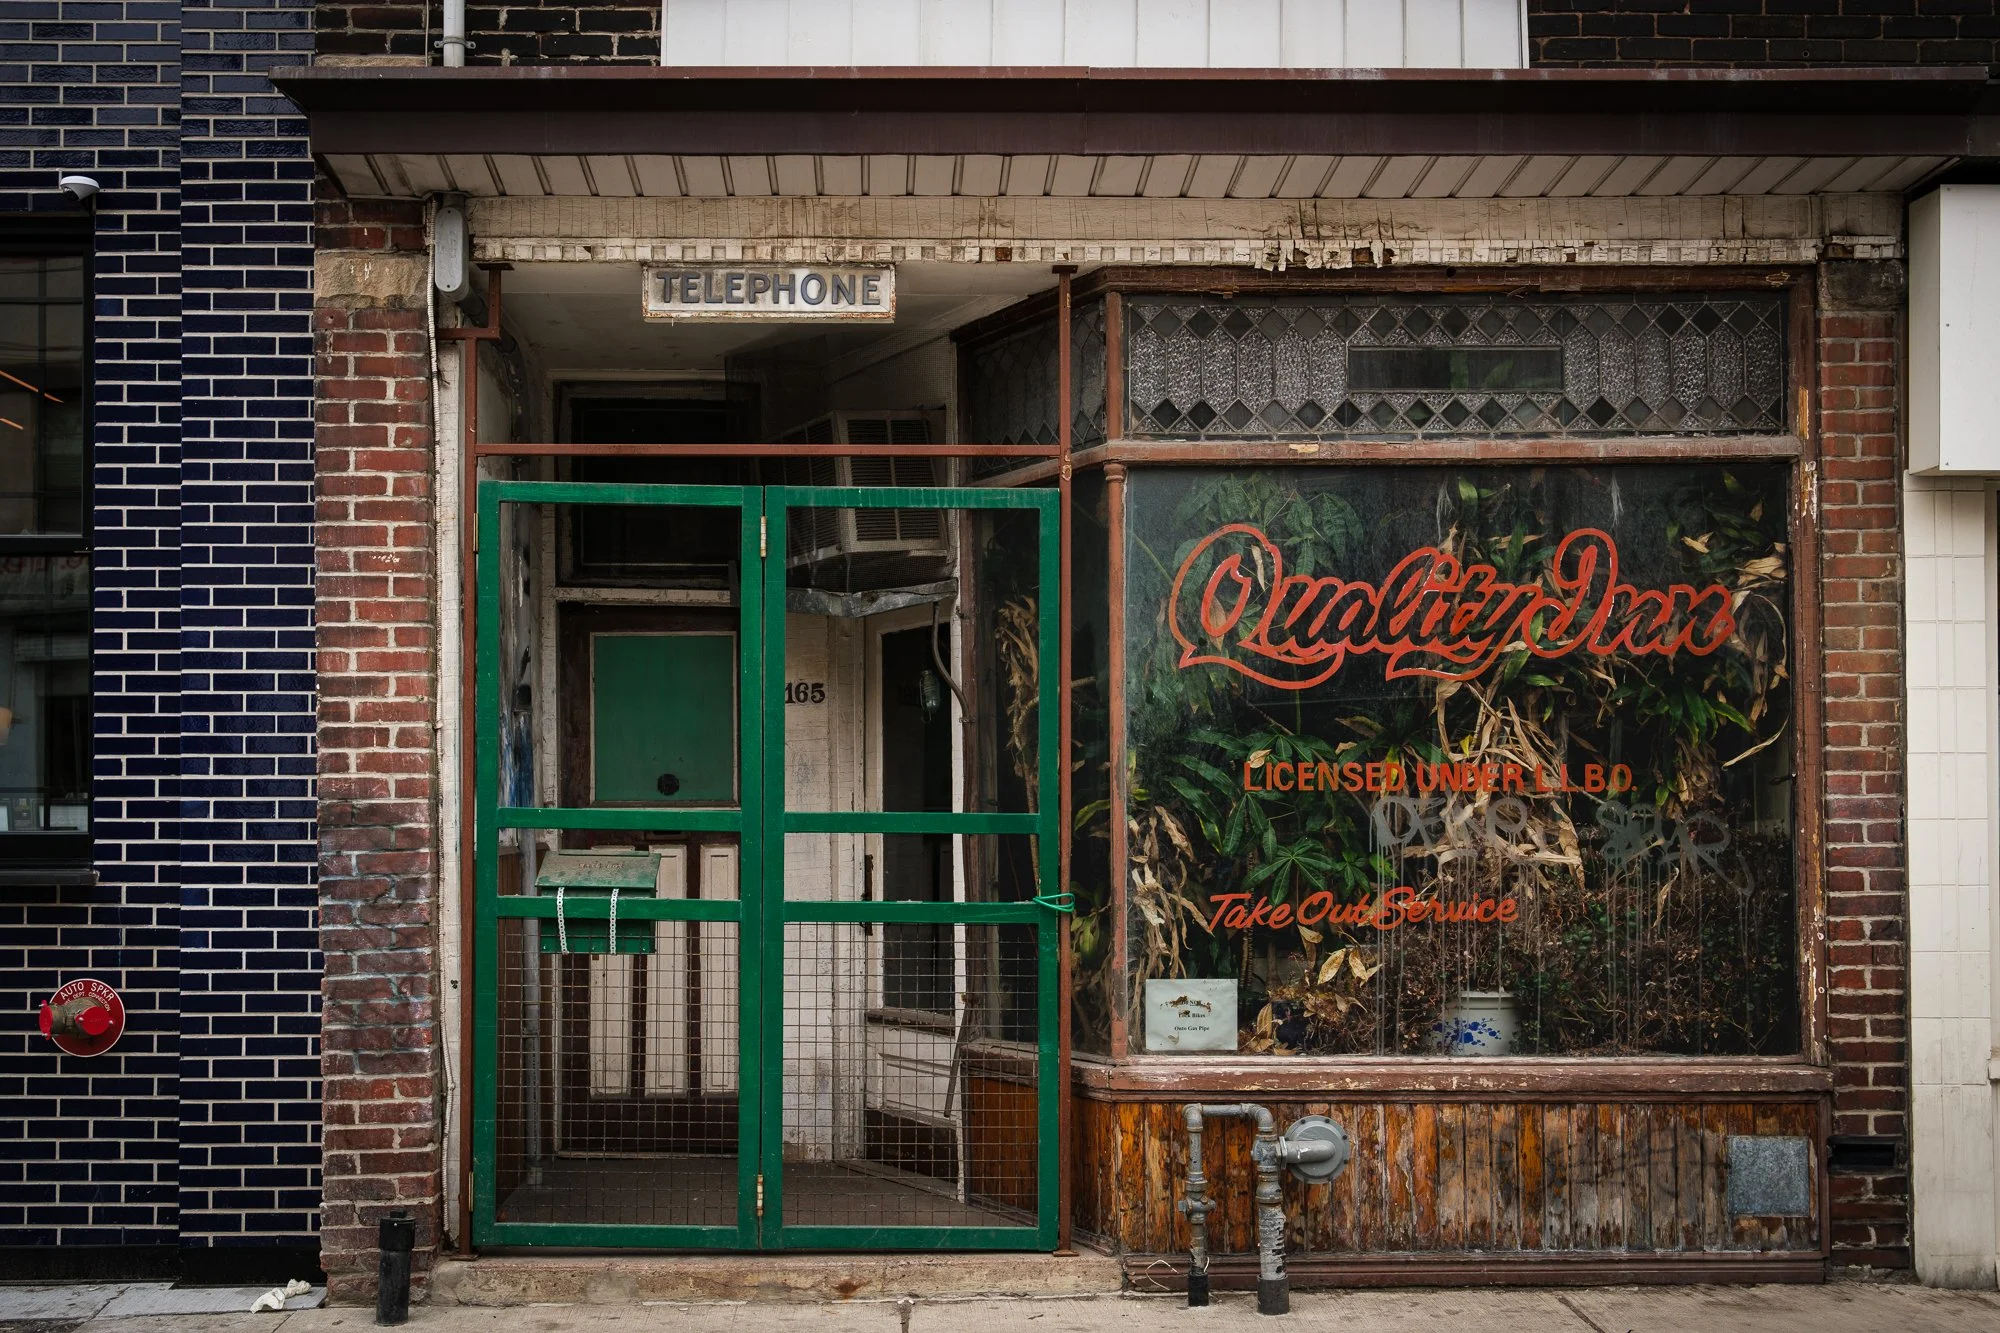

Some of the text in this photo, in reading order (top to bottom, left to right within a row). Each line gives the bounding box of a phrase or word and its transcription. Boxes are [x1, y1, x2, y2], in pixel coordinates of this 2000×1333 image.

[657, 273, 881, 305] TELEPHONE
[1169, 523, 1735, 690] Quality Inn
[785, 682, 826, 704] 165
[1243, 761, 1403, 792] LICENSED
[1416, 762, 1525, 792] UNDER
[1210, 886, 1519, 931] Take Out Service
[60, 981, 115, 1001] AUTO SPKR
[88, 992, 110, 1011] CONNECTION
